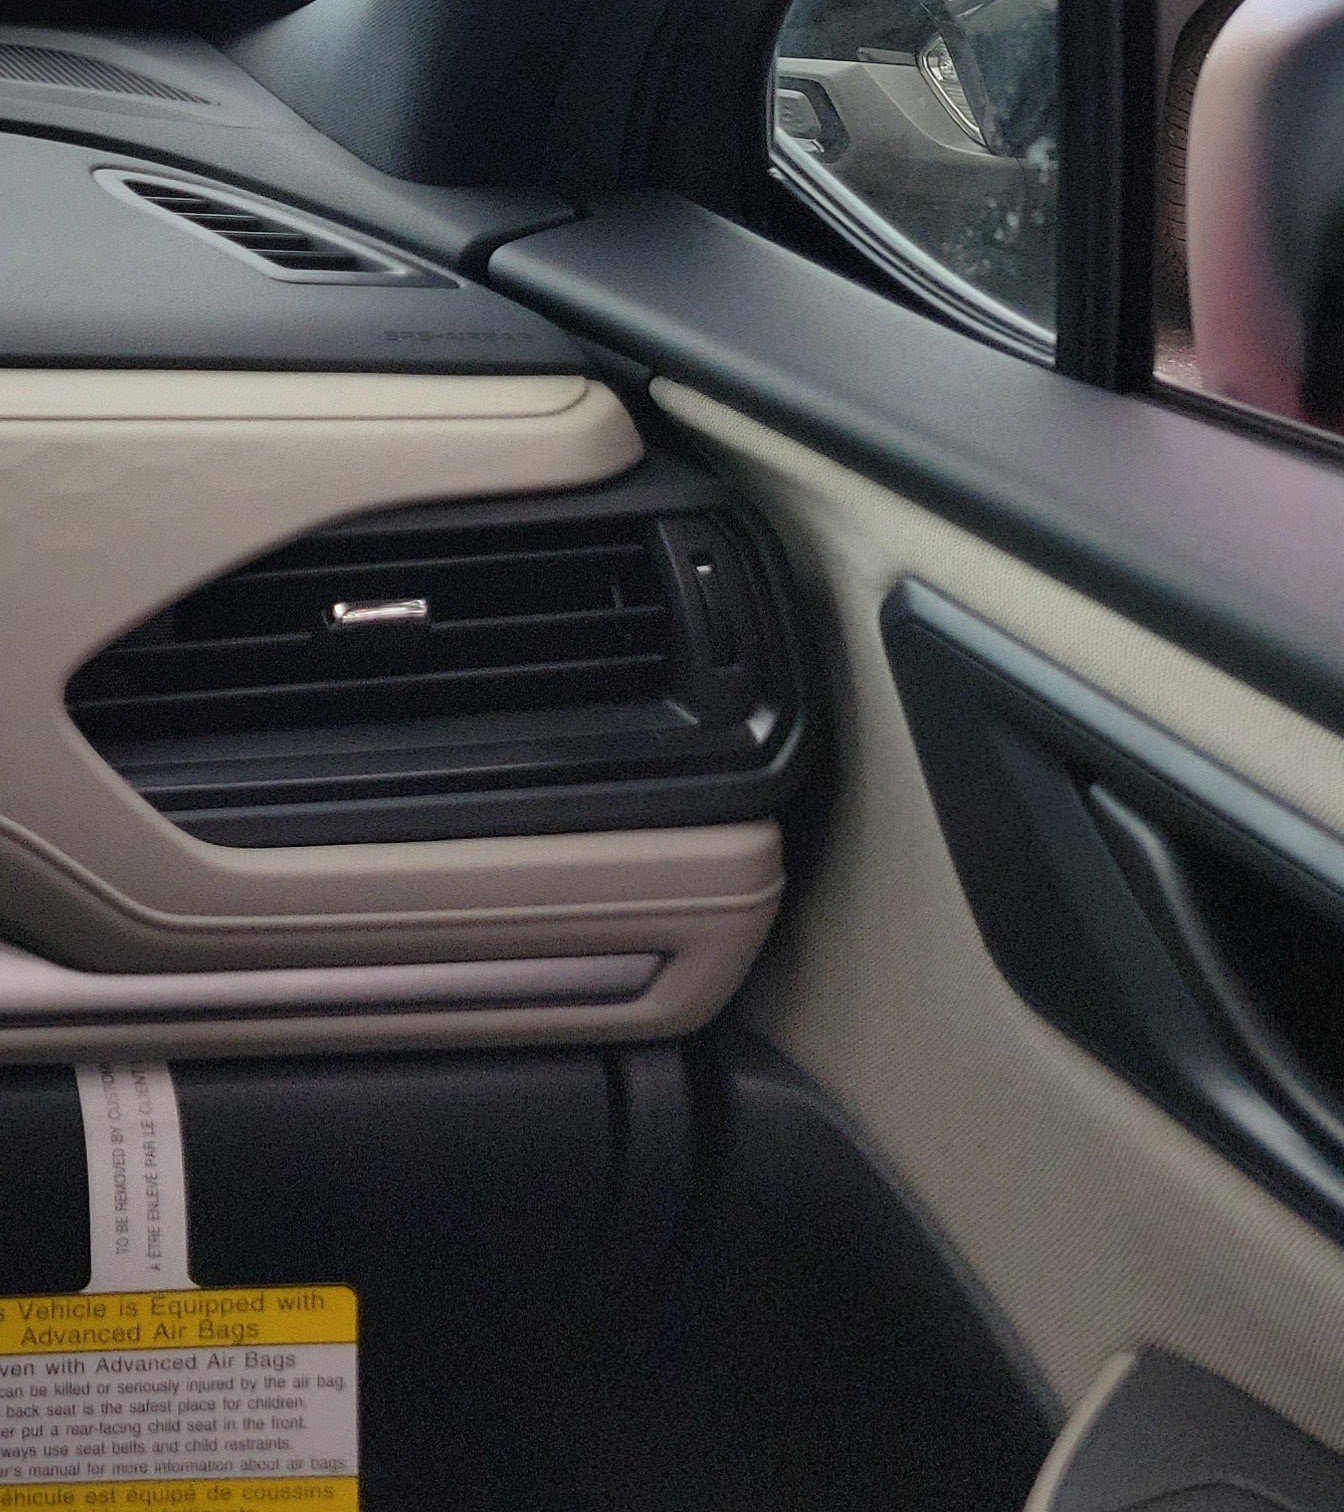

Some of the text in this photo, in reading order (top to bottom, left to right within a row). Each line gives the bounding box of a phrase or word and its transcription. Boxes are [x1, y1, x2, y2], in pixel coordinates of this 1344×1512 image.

[110, 1127, 124, 1144] BY
[140, 1120, 154, 1135] LE
[143, 1140, 158, 1167] PAR
[112, 1148, 128, 1211] REMOVED
[115, 1216, 129, 1232] BE
[115, 1236, 129, 1255] TO
[18, 1298, 106, 1321] Vehicle
[118, 1297, 138, 1317] is
[150, 1294, 264, 1320] Equipped
[277, 1292, 326, 1311] with
[20, 1318, 259, 1346] Advanced Air Bags
[45, 1358, 85, 1375] with
[95, 1354, 197, 1374] Advanced
[206, 1352, 236, 1369] Air
[245, 1350, 297, 1372] Bags
[29, 1384, 48, 1398] be
[53, 1382, 90, 1396] killed
[96, 1383, 112, 1394] or
[116, 1380, 179, 1396] seriously
[185, 1377, 234, 1395] injured
[240, 1377, 257, 1393] by
[264, 1376, 286, 1389] the
[292, 1374, 311, 1388] air
[317, 1373, 347, 1392] bag.
[6, 1404, 39, 1418] back
[46, 1403, 77, 1417] seat
[82, 1402, 94, 1415] is
[101, 1401, 123, 1414] the
[129, 1398, 172, 1413] safest
[178, 1397, 216, 1415] place
[223, 1396, 242, 1410] for
[21, 1423, 44, 1440] put
[50, 1426, 60, 1436] a
[66, 1421, 141, 1438] rear-facing
[147, 1419, 181, 1433] child
[186, 1418, 217, 1432] seat
[223, 1417, 236, 1430] in
[242, 1416, 265, 1430] the
[43, 1445, 69, 1457] use
[75, 1442, 106, 1456] seat
[112, 1440, 145, 1455] belts
[152, 1439, 178, 1453] and
[185, 1437, 218, 1452] child
[28, 1462, 81, 1478] manual
[87, 1461, 106, 1475] for
[112, 1461, 148, 1475] more
[154, 1457, 233, 1474] information
[240, 1456, 280, 1472] about
[286, 1456, 303, 1470] air
[85, 1488, 116, 1505] est
[206, 1485, 232, 1501] de
